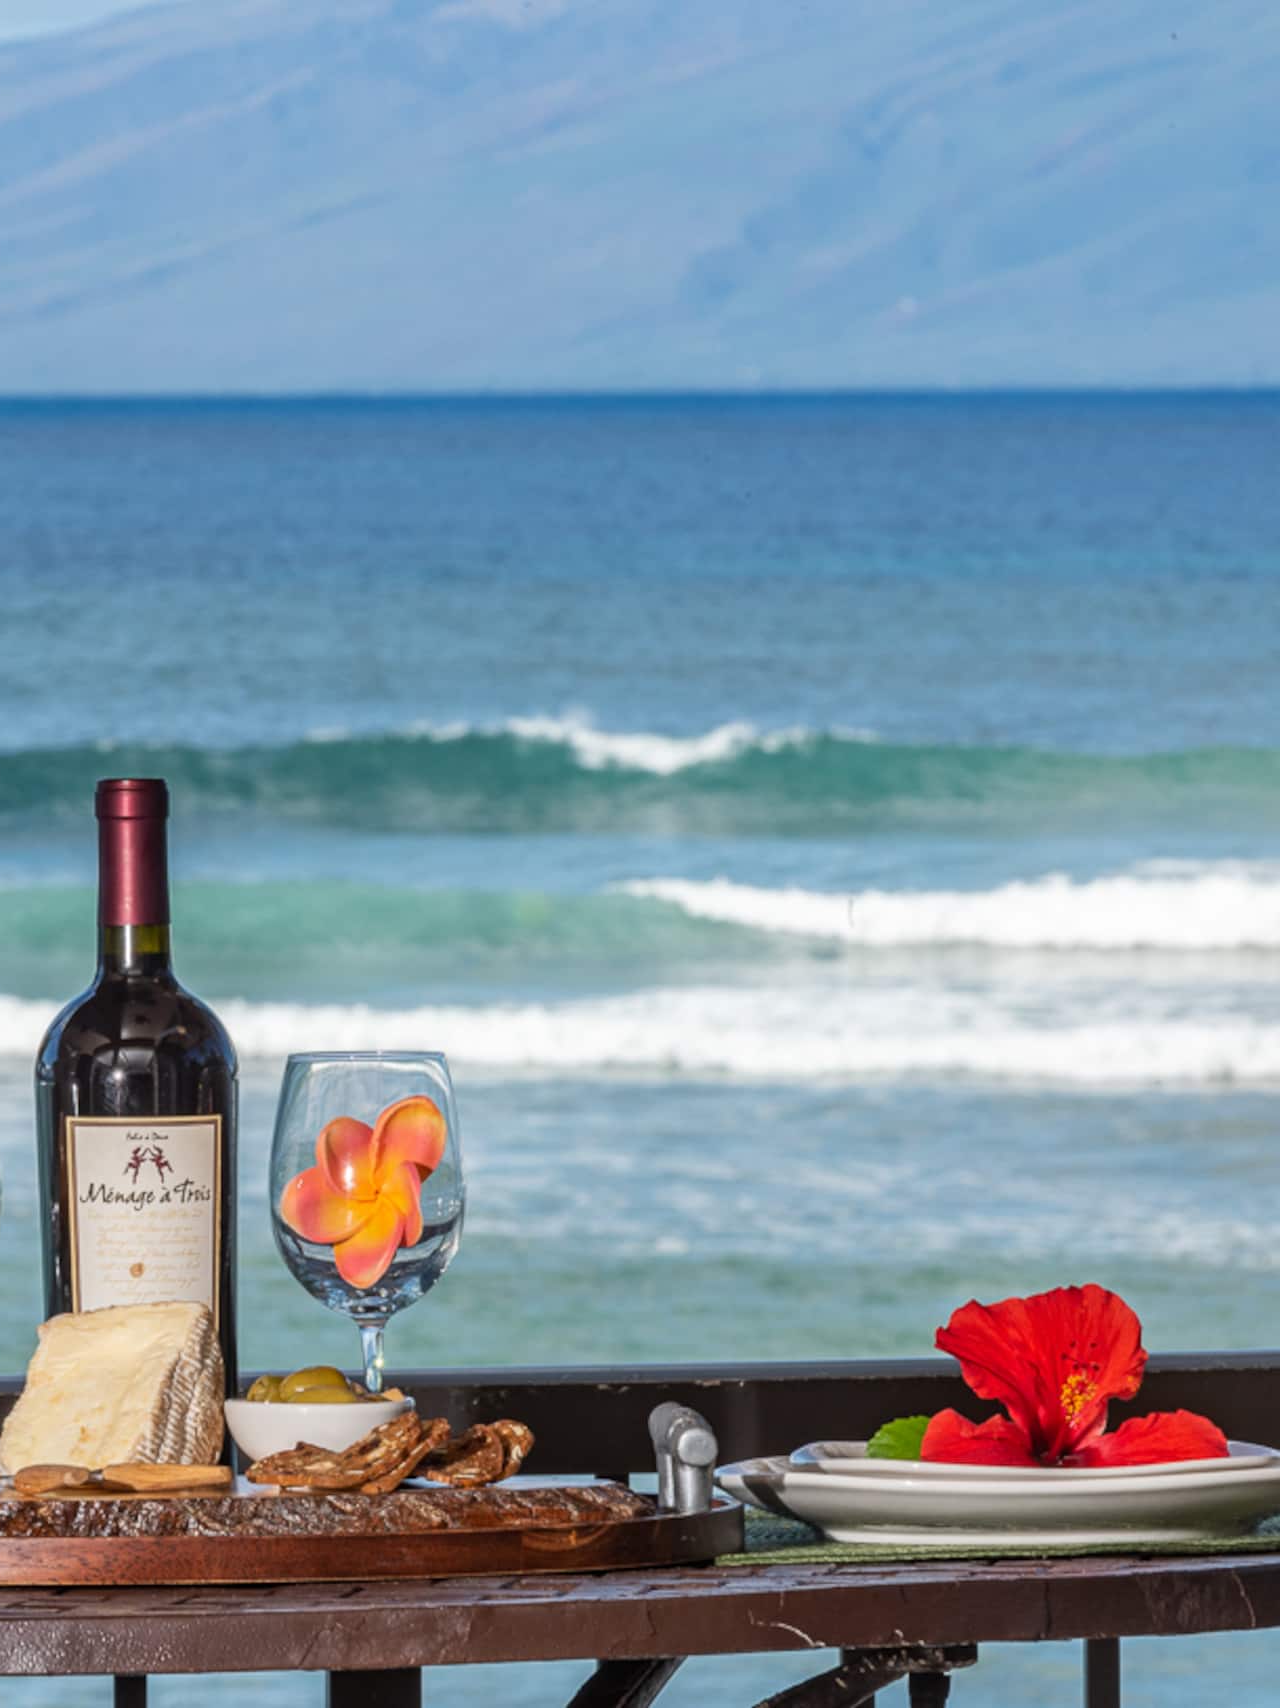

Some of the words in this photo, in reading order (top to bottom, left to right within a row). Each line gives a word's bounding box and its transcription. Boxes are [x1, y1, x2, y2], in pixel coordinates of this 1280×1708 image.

[80, 1182, 155, 1211] Ménage
[160, 1186, 171, 1203] à
[173, 1178, 211, 1203] Trois
